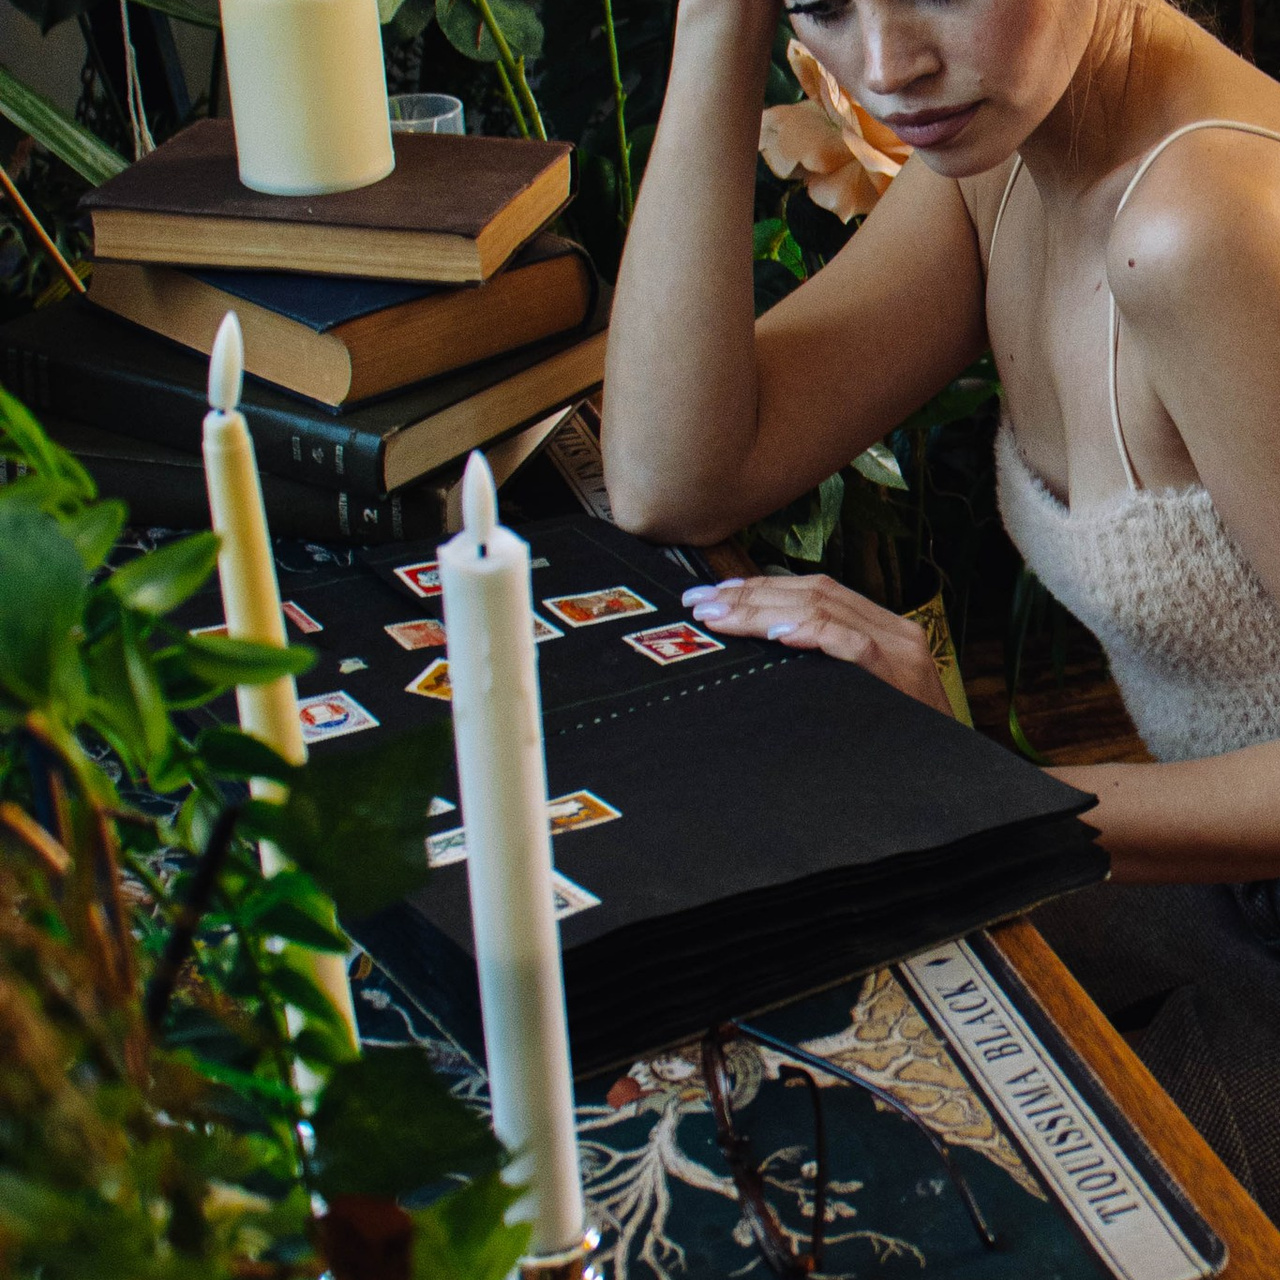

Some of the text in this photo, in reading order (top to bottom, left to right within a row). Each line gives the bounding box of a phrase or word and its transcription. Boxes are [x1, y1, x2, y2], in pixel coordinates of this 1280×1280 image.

[363, 507, 378, 524] 2
[936, 979, 1139, 1226] TIQUISSIMA BLACK
